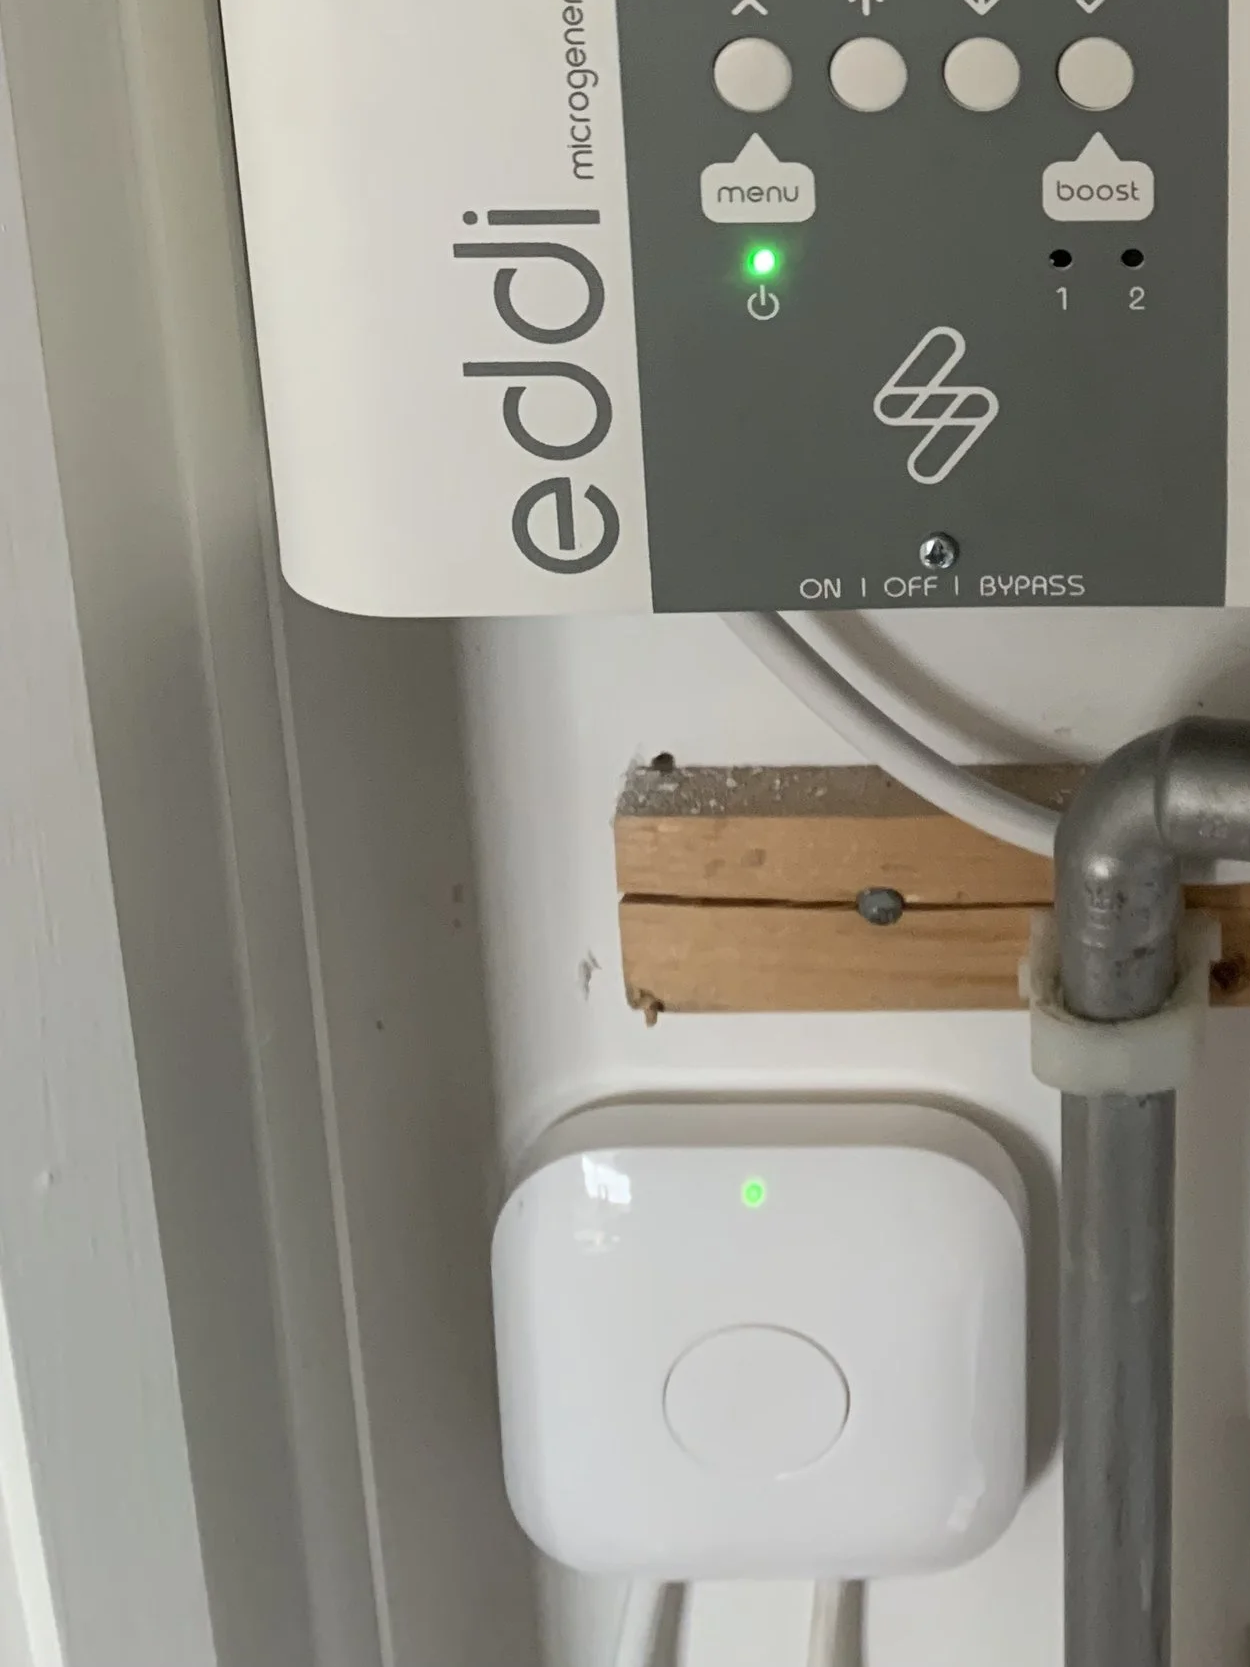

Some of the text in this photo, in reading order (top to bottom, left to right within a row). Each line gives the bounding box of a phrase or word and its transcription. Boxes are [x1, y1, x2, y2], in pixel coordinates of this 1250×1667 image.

[717, 184, 800, 203] menu
[1056, 180, 1140, 201] boost
[1056, 287, 1068, 310] 1
[1128, 287, 1145, 310] 2
[452, 209, 620, 575] eddi
[799, 578, 842, 598] ON
[883, 577, 938, 598] OFF
[979, 574, 1086, 597] BYPASS
